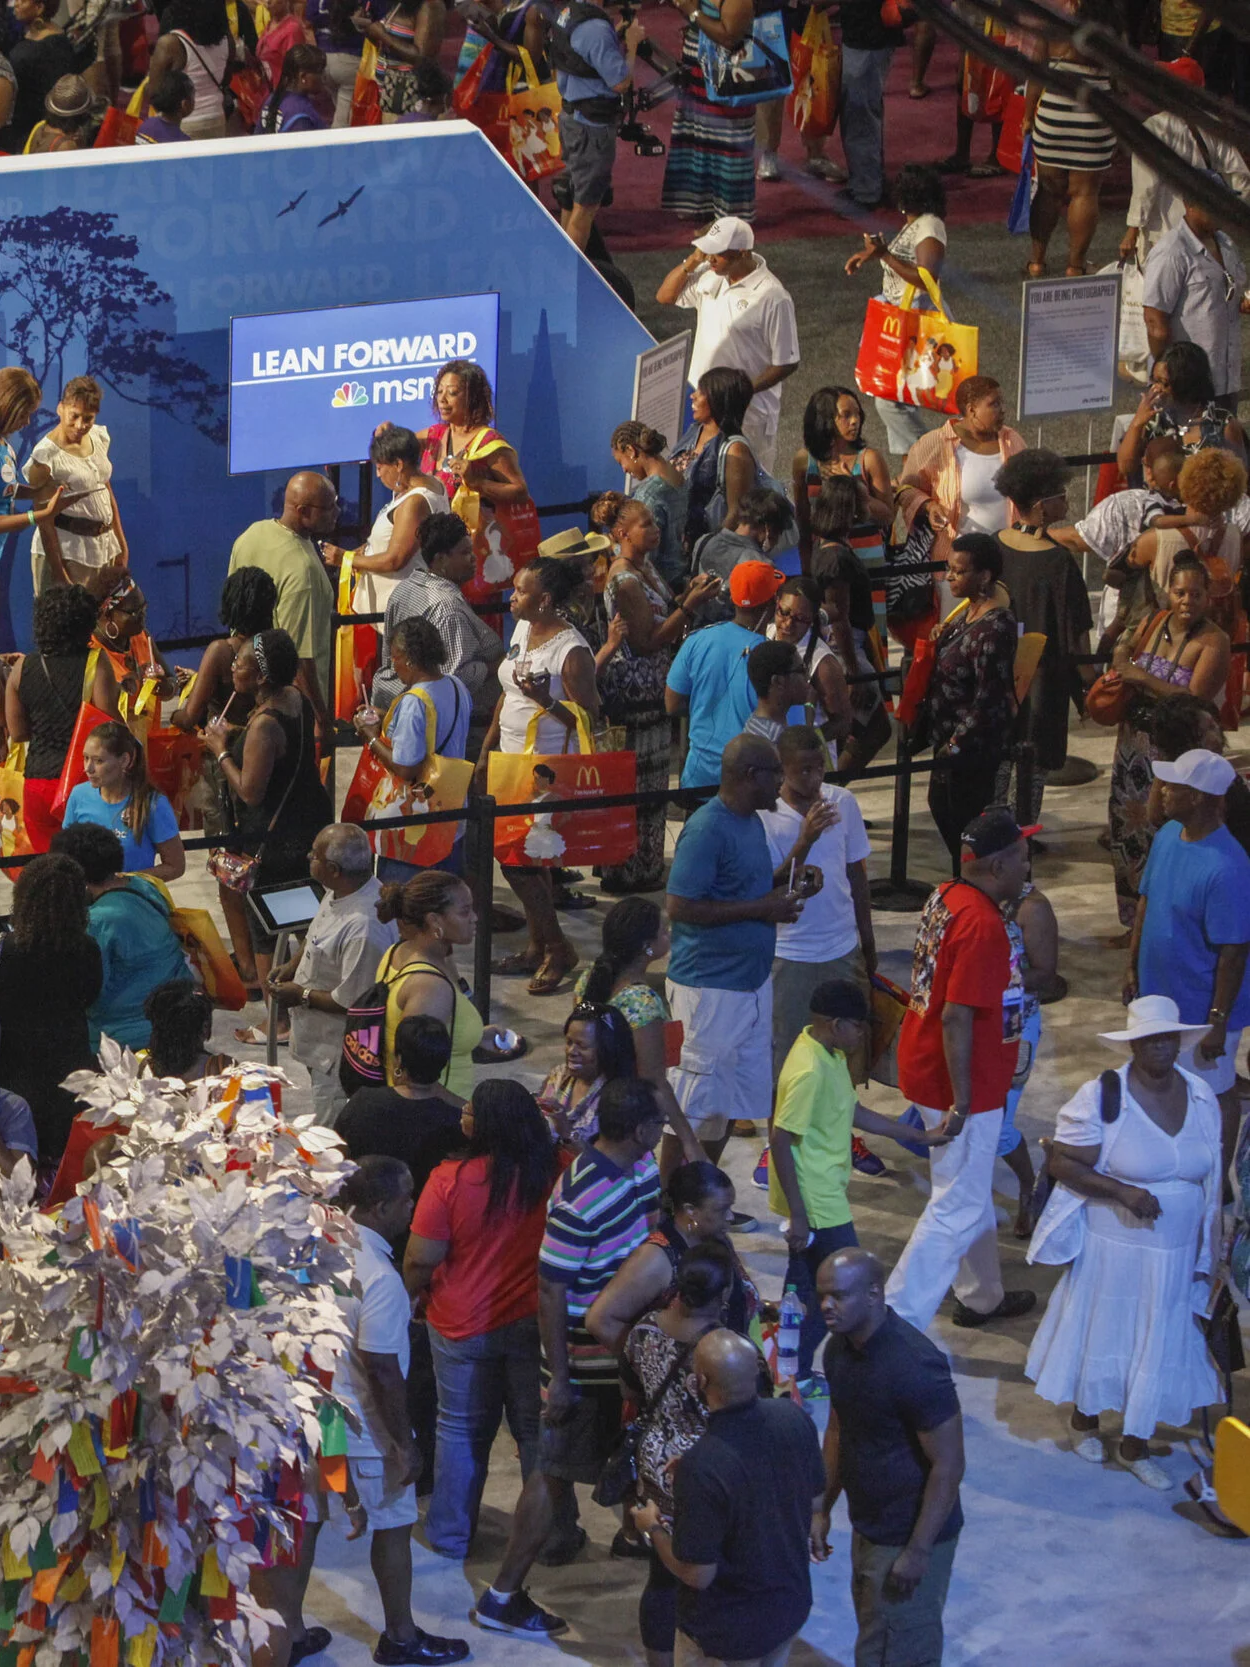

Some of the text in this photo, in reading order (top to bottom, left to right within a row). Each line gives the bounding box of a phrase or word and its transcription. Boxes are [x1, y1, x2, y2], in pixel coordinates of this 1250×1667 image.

[1030, 283, 1116, 304] YOU ARE BEING PHOTOGRAPHED
[253, 331, 477, 378] LEAN FORWARD
[373, 376, 436, 405] msn
[344, 1033, 382, 1067] adidas
